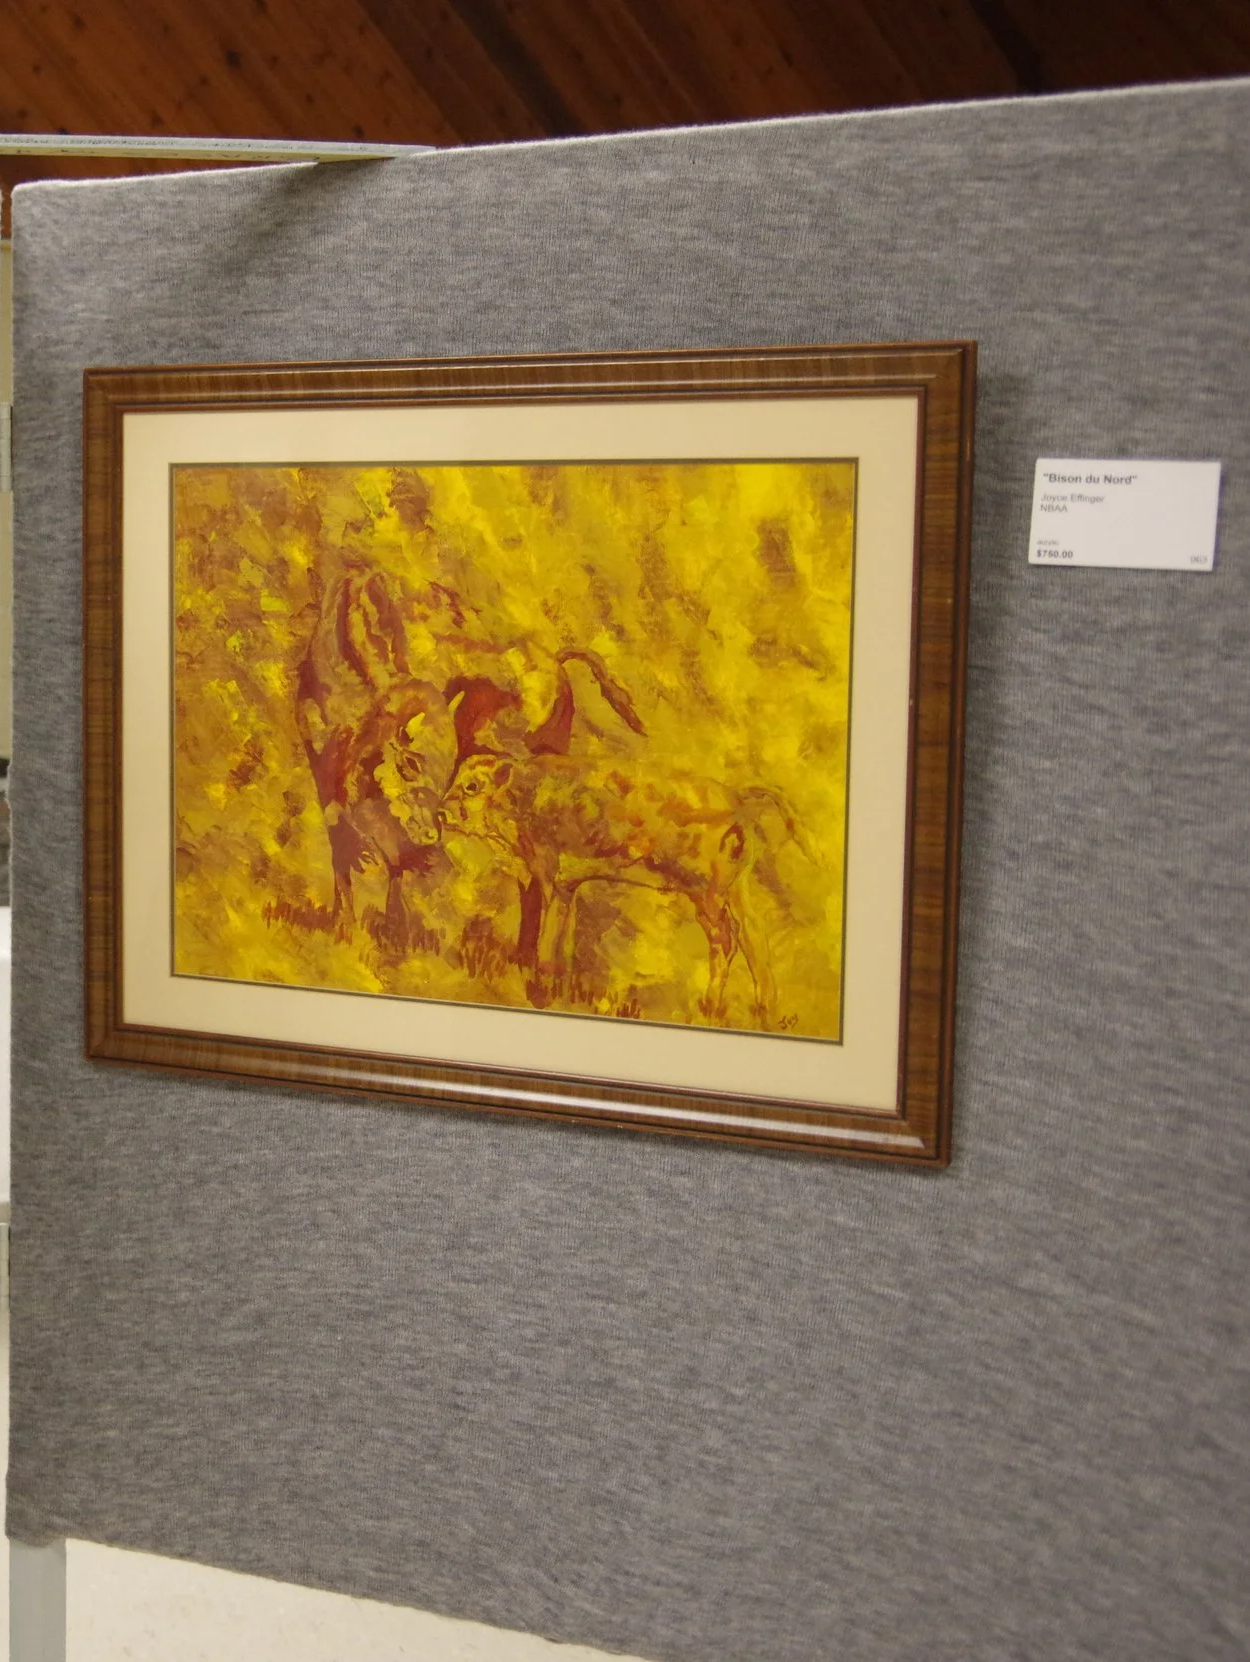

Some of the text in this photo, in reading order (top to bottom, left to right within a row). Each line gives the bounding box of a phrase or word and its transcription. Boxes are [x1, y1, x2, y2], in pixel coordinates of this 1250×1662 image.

[1043, 473, 1137, 485] "Bison du Nord"
[1041, 494, 1104, 504] Joyce Effinger
[1040, 504, 1068, 513] NBAA
